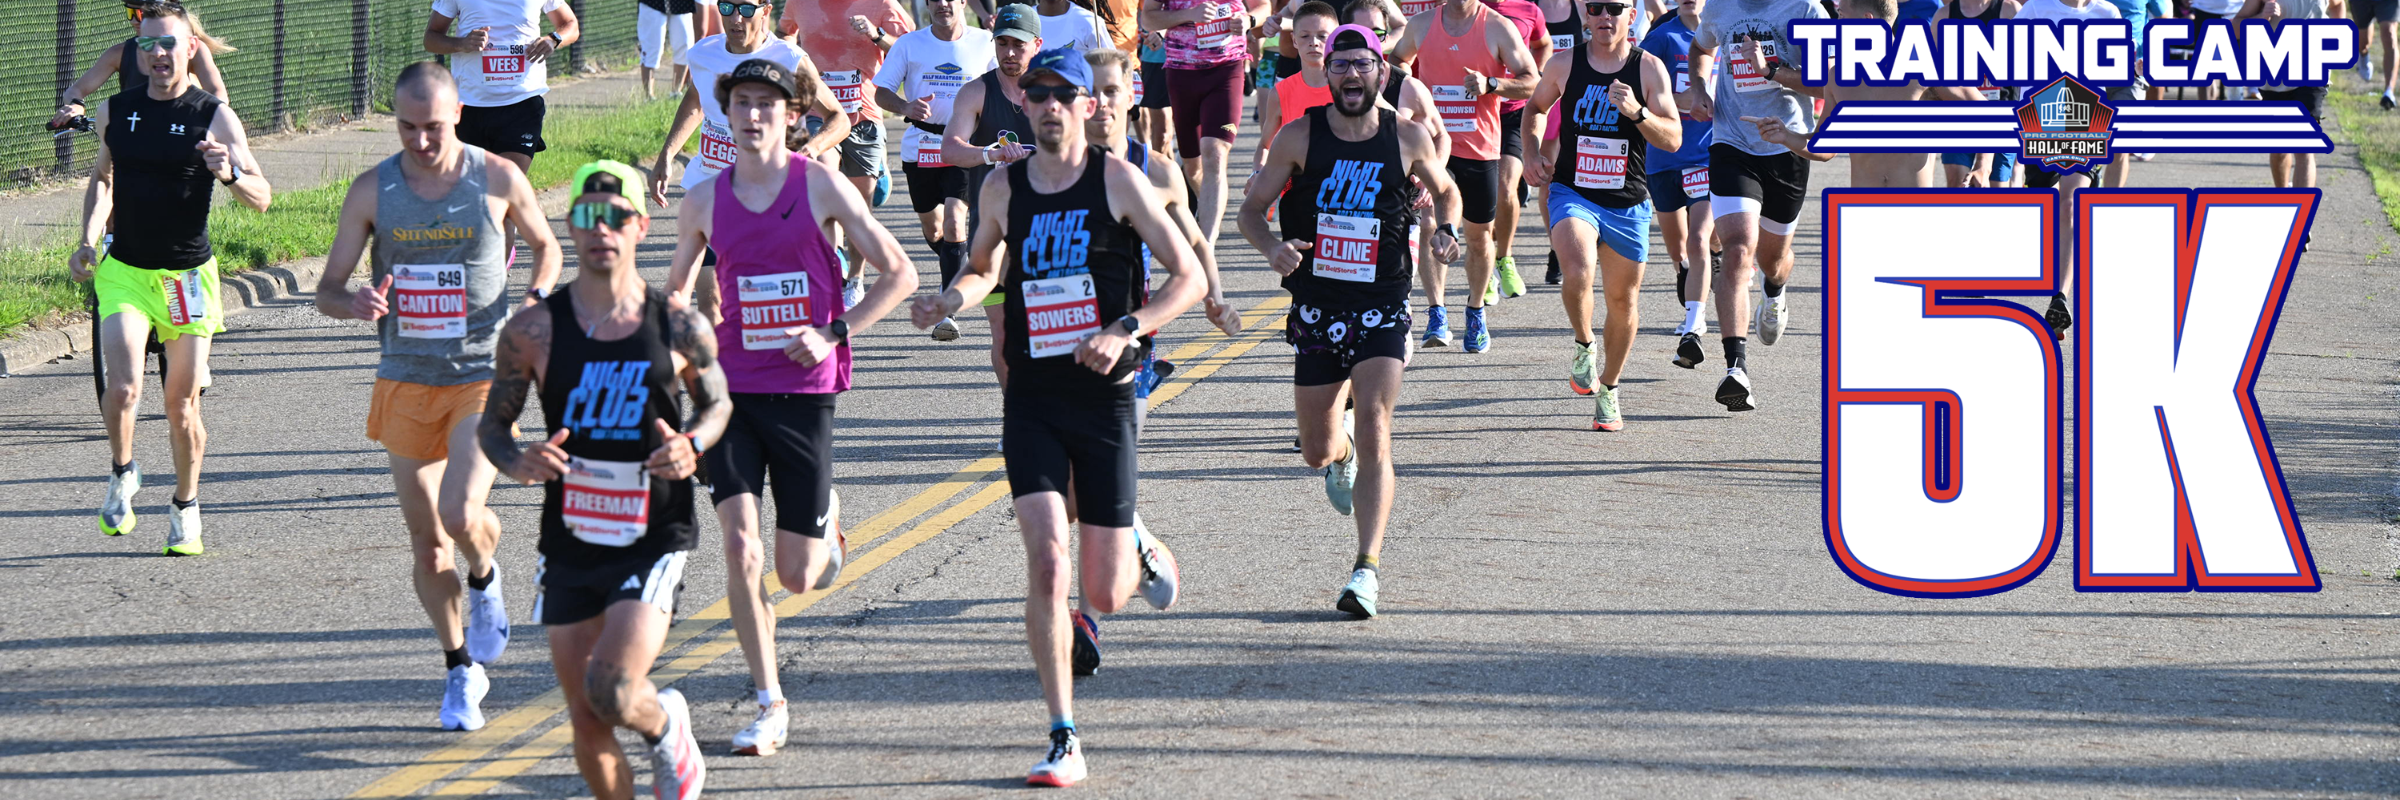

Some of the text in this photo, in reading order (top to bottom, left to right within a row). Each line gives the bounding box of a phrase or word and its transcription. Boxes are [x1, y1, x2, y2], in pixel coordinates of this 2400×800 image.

[510, 45, 524, 54] 598
[1559, 38, 1572, 47] 681
[489, 57, 519, 72] VEES
[736, 63, 780, 82] ciele
[1573, 98, 1620, 125] CLUB
[919, 153, 943, 163] EKST
[1620, 143, 1627, 155] 9
[1330, 159, 1385, 182] NIGHT
[1577, 156, 1625, 173] ADAMS
[1316, 177, 1383, 210] CLUB
[1029, 209, 1089, 237] NIGHT
[1370, 224, 1378, 238] 4
[1022, 230, 1091, 274] CLUB
[1321, 238, 1372, 262] CLINE
[438, 270, 462, 287] 649
[781, 278, 804, 296] 571
[1083, 280, 1092, 297] 2
[398, 294, 464, 313] CANTON
[741, 302, 809, 325] SUTTELL
[1028, 304, 1097, 331] SOWERS
[579, 361, 652, 389] NIGHT
[562, 387, 649, 429] CLUB
[564, 489, 645, 517] FREEMAN
